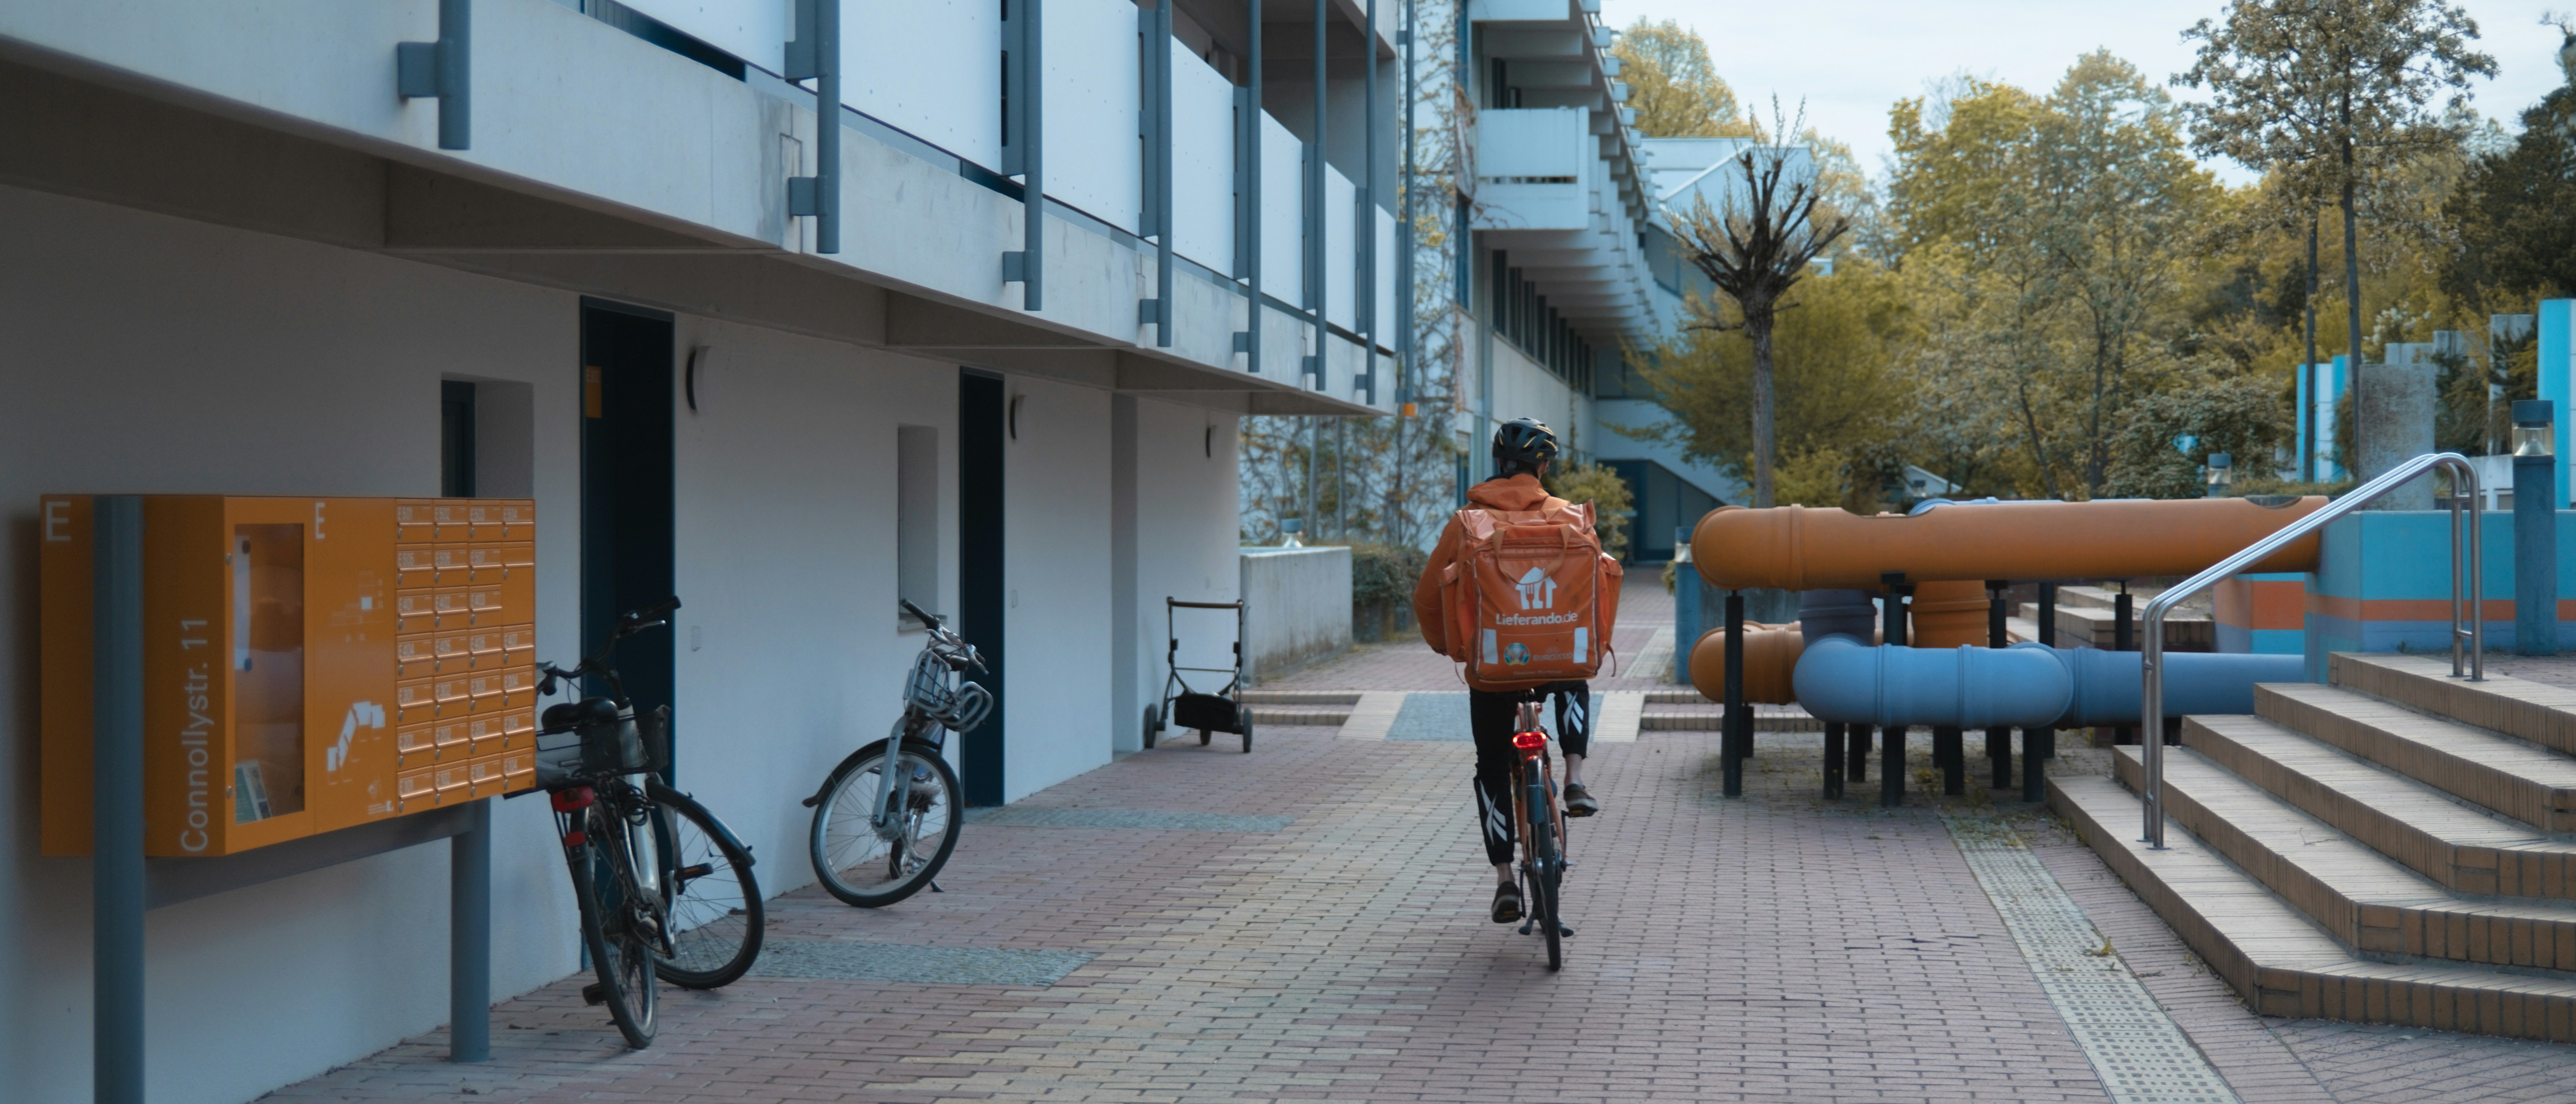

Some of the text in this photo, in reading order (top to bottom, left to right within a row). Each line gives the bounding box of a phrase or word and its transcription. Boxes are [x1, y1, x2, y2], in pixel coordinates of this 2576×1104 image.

[45, 500, 72, 542] E
[315, 502, 326, 539] E
[1495, 610, 1578, 625] Lieferando.de
[181, 617, 214, 853] Connollystr. 11
